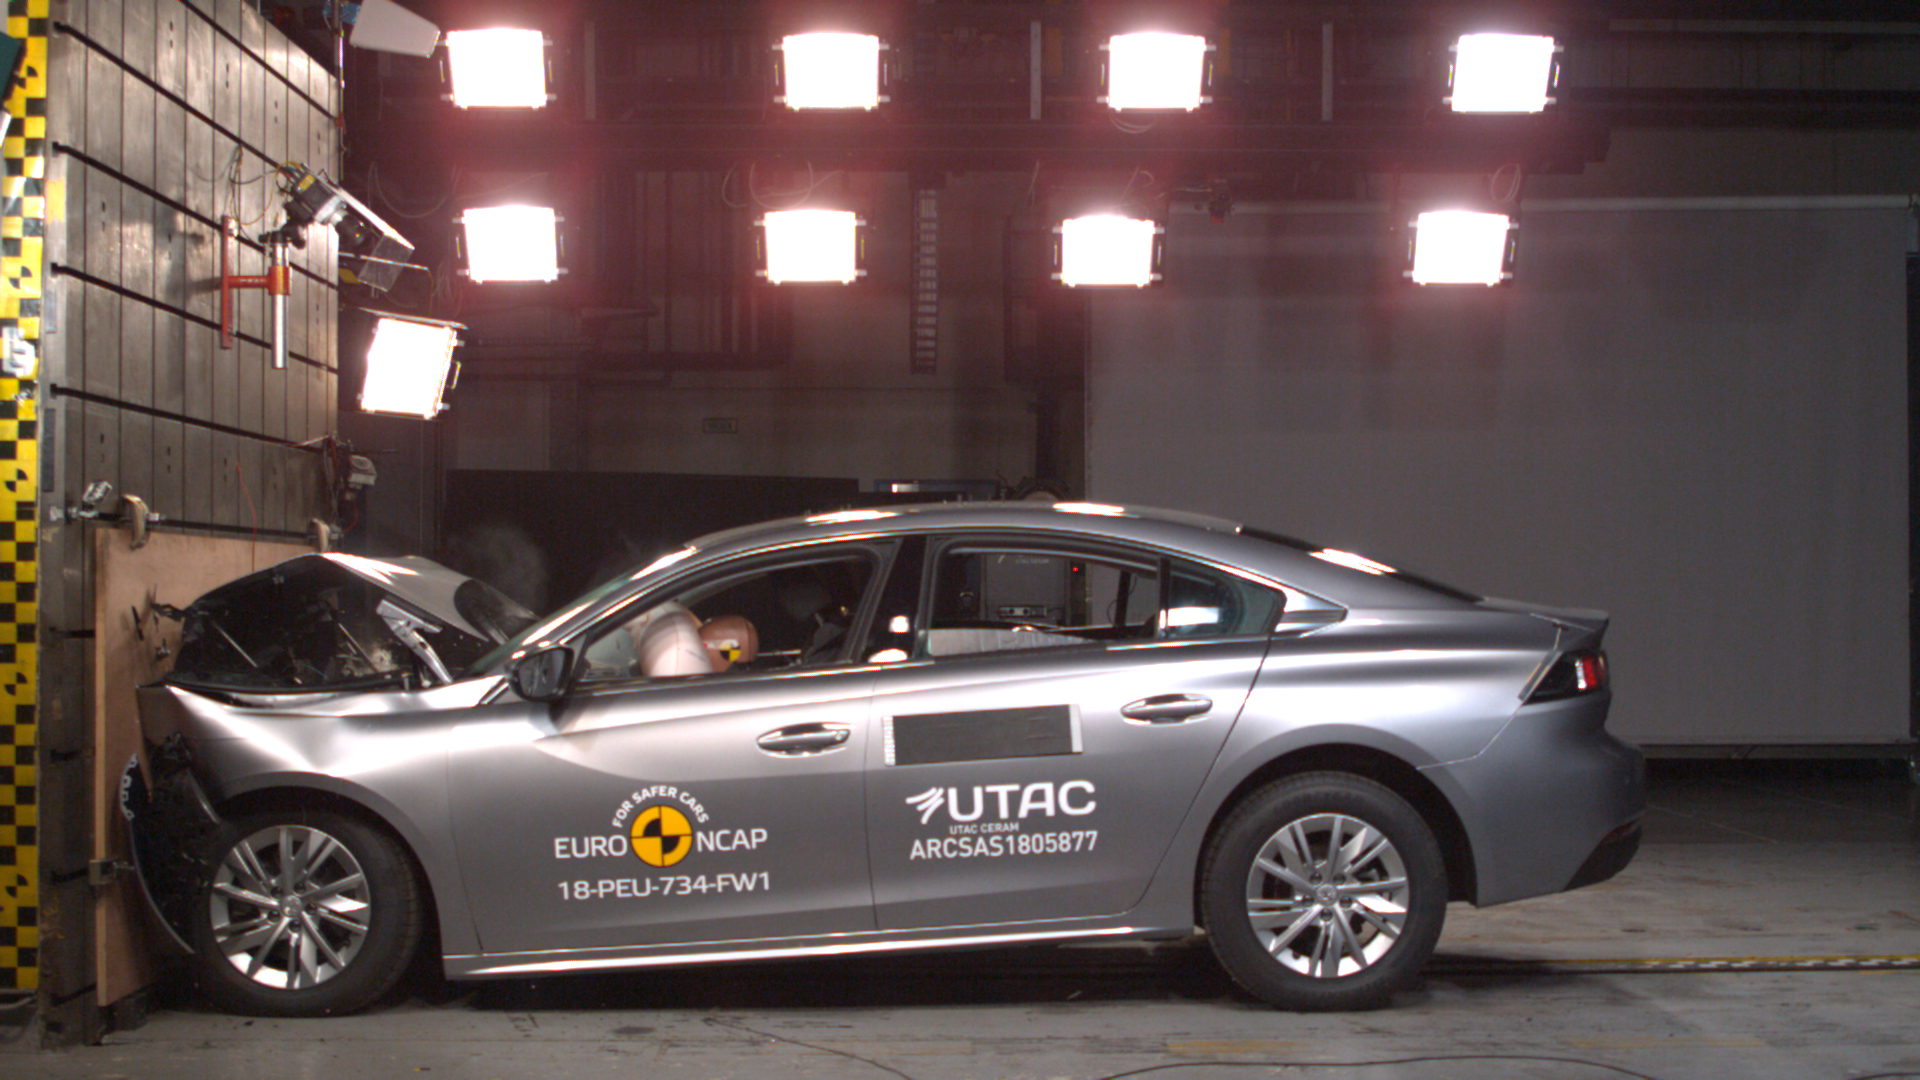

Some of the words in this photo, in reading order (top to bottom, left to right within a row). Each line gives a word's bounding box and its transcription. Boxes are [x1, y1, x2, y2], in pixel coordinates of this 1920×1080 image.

[611, 800, 634, 828] FOR
[632, 785, 677, 804] SAFER
[679, 792, 709, 823] CARS
[947, 779, 1097, 822] UTAC
[554, 834, 628, 859] EURO
[696, 828, 768, 852] NCAP
[949, 825, 978, 835] UTAC
[980, 822, 1019, 834] CERAM
[909, 830, 1098, 860] ARCSAS1805877
[558, 871, 770, 900] 18-PEU-734-FW1
